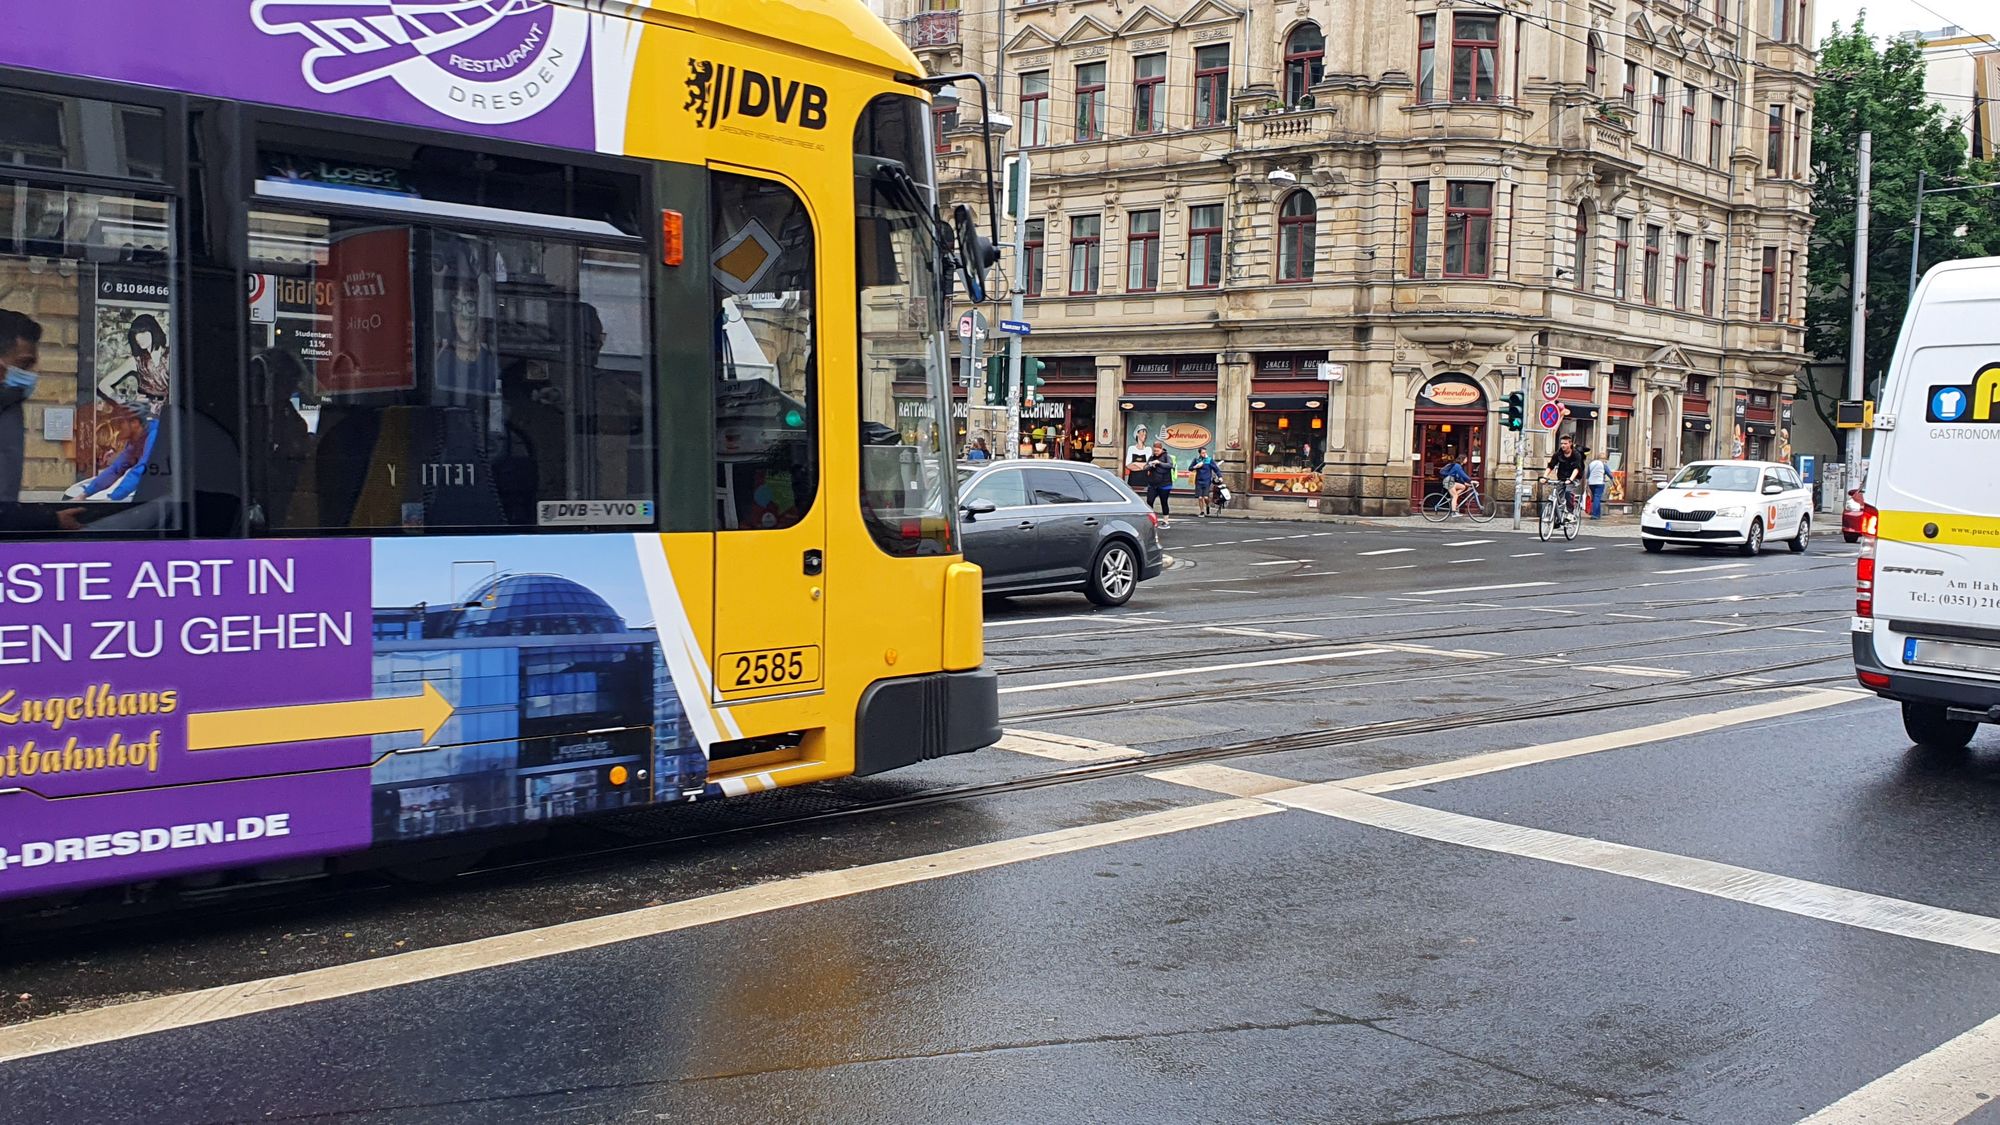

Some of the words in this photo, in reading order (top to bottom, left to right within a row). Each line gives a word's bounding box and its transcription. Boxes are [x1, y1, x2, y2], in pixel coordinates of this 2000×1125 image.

[449, 23, 544, 73] RESTAURANT
[449, 47, 565, 110] DRESDEN
[738, 69, 828, 131] DVB
[116, 282, 135, 294] 810
[136, 283, 156, 296] 848
[157, 286, 169, 296] 66
[309, 340, 325, 348] 11%
[1545, 382, 1556, 394] 30
[558, 503, 588, 517] DVB
[603, 503, 636, 516] VVO
[1882, 566, 1945, 576] SPRINTER
[0, 562, 112, 603] STE
[127, 559, 234, 599] ART
[248, 558, 295, 595] IN
[1947, 579, 1968, 589] Am
[1909, 591, 1935, 603] Tel.:
[1938, 593, 1977, 608] (0351)
[1981, 597, 2000, 608] 216
[90, 619, 164, 660] ZU
[180, 611, 352, 655] GEHEN
[735, 651, 803, 687] 2585
